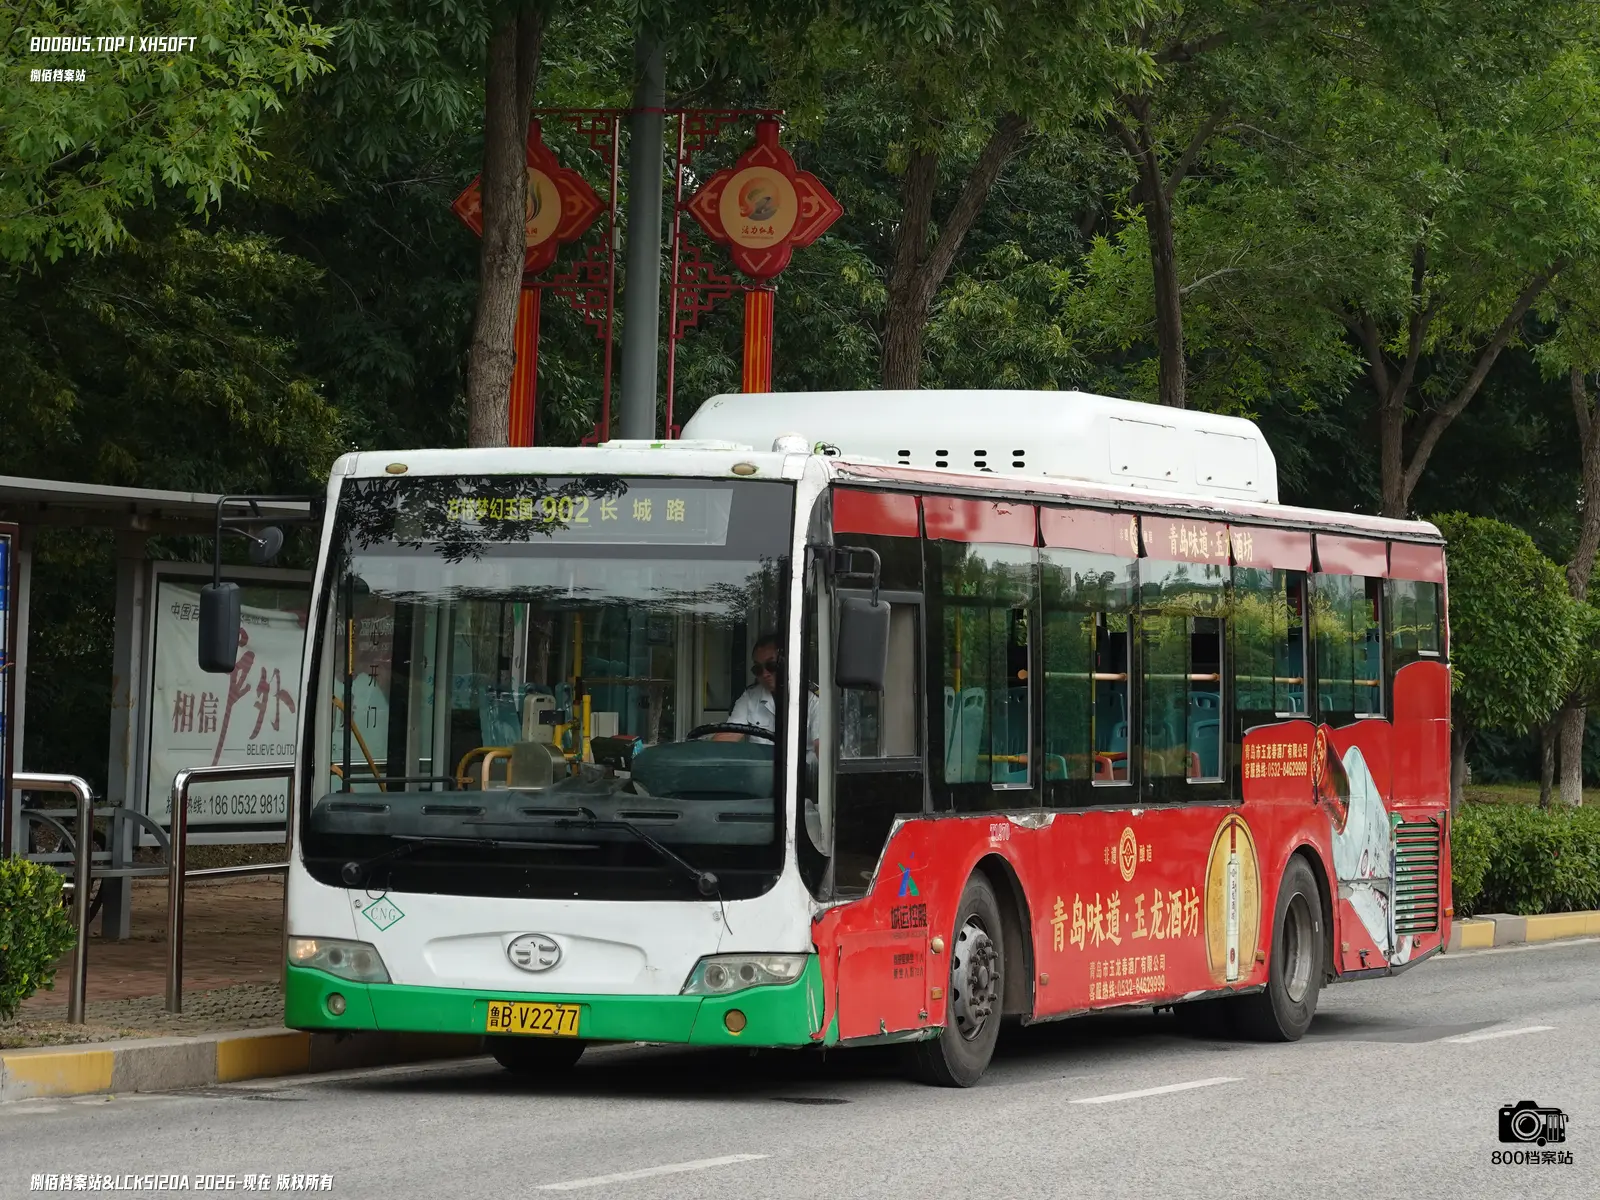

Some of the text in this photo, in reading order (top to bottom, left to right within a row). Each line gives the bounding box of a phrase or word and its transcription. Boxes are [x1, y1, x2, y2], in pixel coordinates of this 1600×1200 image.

[541, 495, 590, 523] 902
[600, 498, 686, 522] 长城路
[172, 689, 219, 734] 相信
[247, 744, 275, 756] BELIEVE
[1244, 744, 1308, 760] 青岛市玉龙春酒厂有限公司
[209, 795, 228, 815] 186
[231, 794, 257, 815] 0532
[260, 794, 285, 814] 9813
[370, 906, 396, 921] CNG
[1050, 886, 1200, 952] 青岛味道·玉龙酒坊
[1089, 953, 1166, 980] 青岛市玉龙春酒厂有限公司
